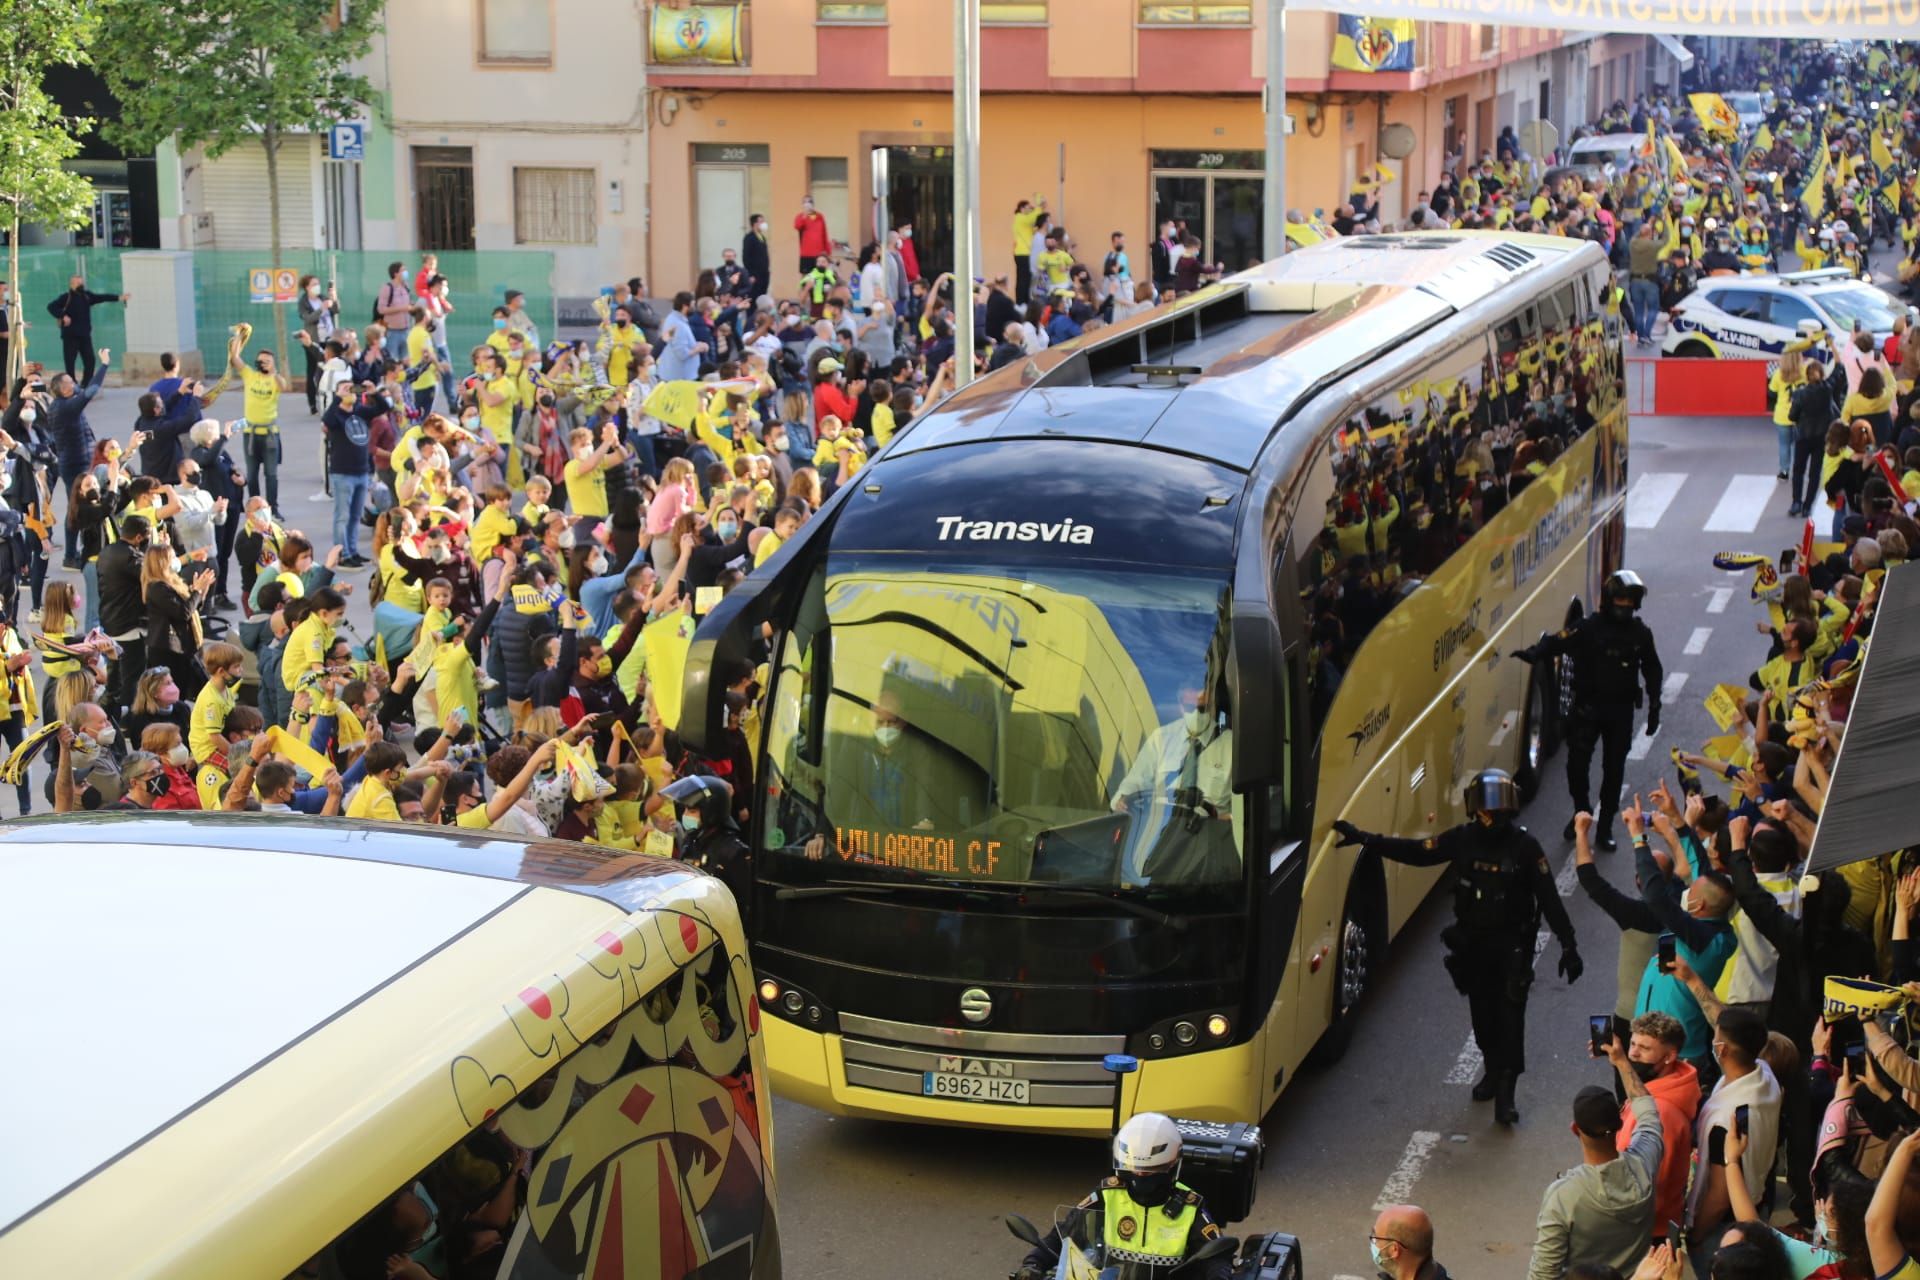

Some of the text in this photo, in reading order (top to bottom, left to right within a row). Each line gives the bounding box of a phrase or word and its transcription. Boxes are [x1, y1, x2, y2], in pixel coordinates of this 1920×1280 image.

[335, 126, 357, 157] P
[721, 148, 748, 160] 205
[1196, 153, 1224, 168] 209
[936, 515, 1094, 545] Transvia
[836, 827, 960, 873] VILLARREAL
[939, 1056, 1015, 1078] MAN
[936, 1075, 982, 1097] 6962
[989, 1080, 1025, 1101] HZC
